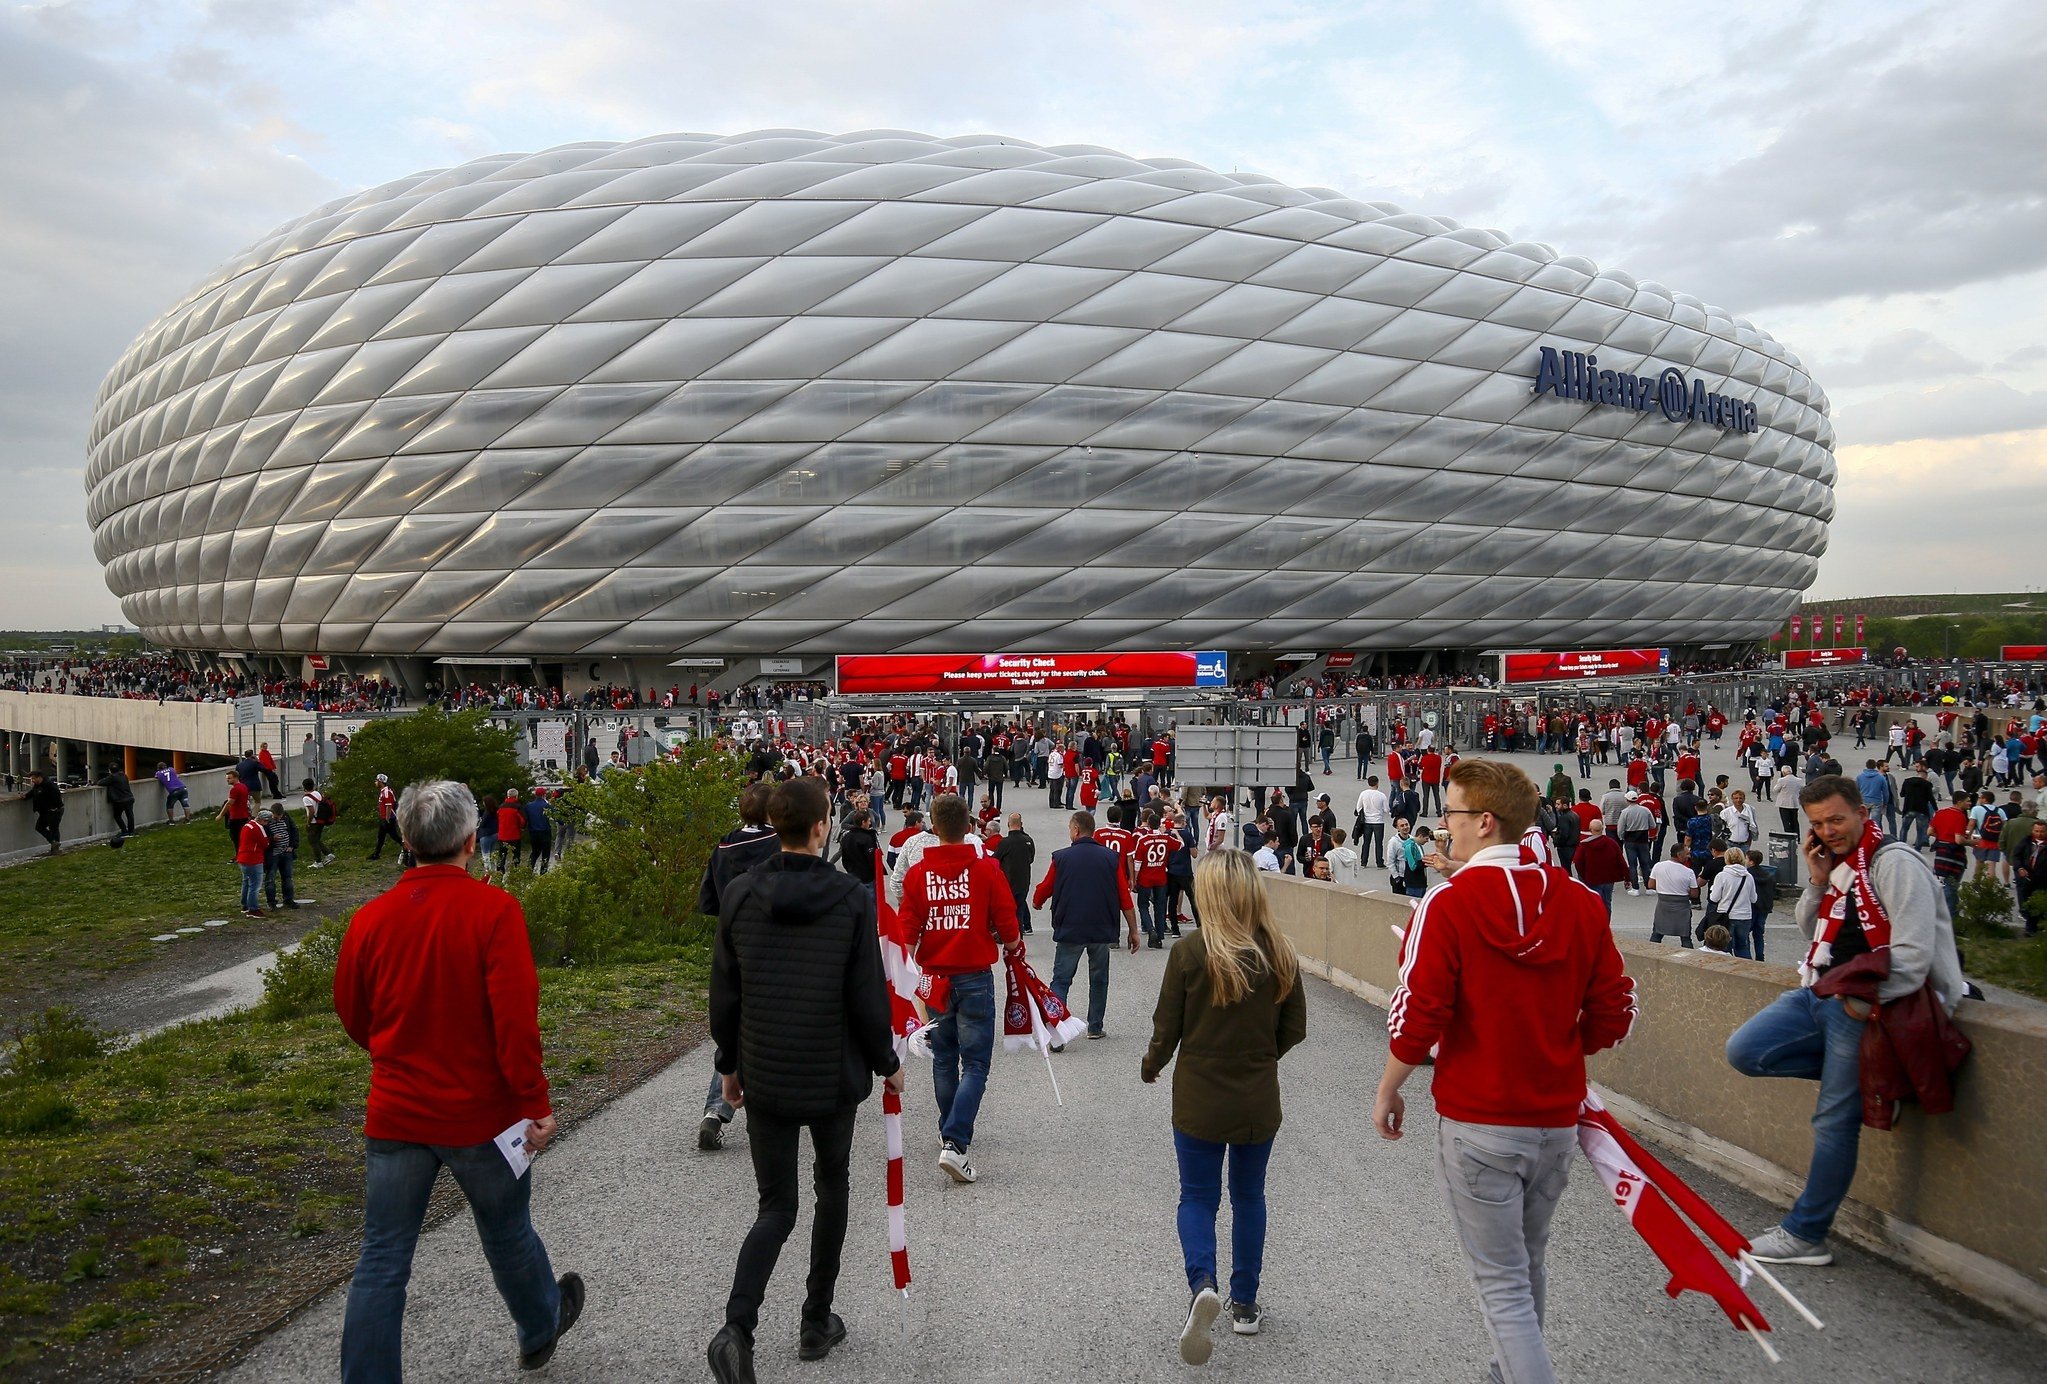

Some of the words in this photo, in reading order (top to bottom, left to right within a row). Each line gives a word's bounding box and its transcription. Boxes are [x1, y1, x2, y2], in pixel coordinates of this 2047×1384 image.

[1535, 346, 1658, 413] Allianz
[1693, 378, 1759, 434] Arena
[999, 658, 1031, 668] Security
[1032, 657, 1055, 667] Check
[589, 662, 600, 682] C
[943, 671, 965, 679] Please
[967, 671, 982, 680] keep
[983, 671, 998, 680] your
[999, 670, 1020, 678] tickets
[1021, 670, 1039, 678] ready
[1040, 669, 1050, 677] for
[1051, 669, 1062, 677] the
[1062, 669, 1087, 678] security
[1088, 668, 1108, 676] check.
[1030, 678, 1045, 686] you!
[607, 723, 616, 731] 50
[734, 722, 741, 730] 49
[164, 771, 170, 781] 7
[1147, 844, 1166, 862] 69
[926, 868, 968, 886] EUR
[926, 883, 970, 901] HASS
[944, 904, 970, 916] UNSER
[926, 914, 970, 931] STOLZ
[1858, 910, 1876, 932] FC
